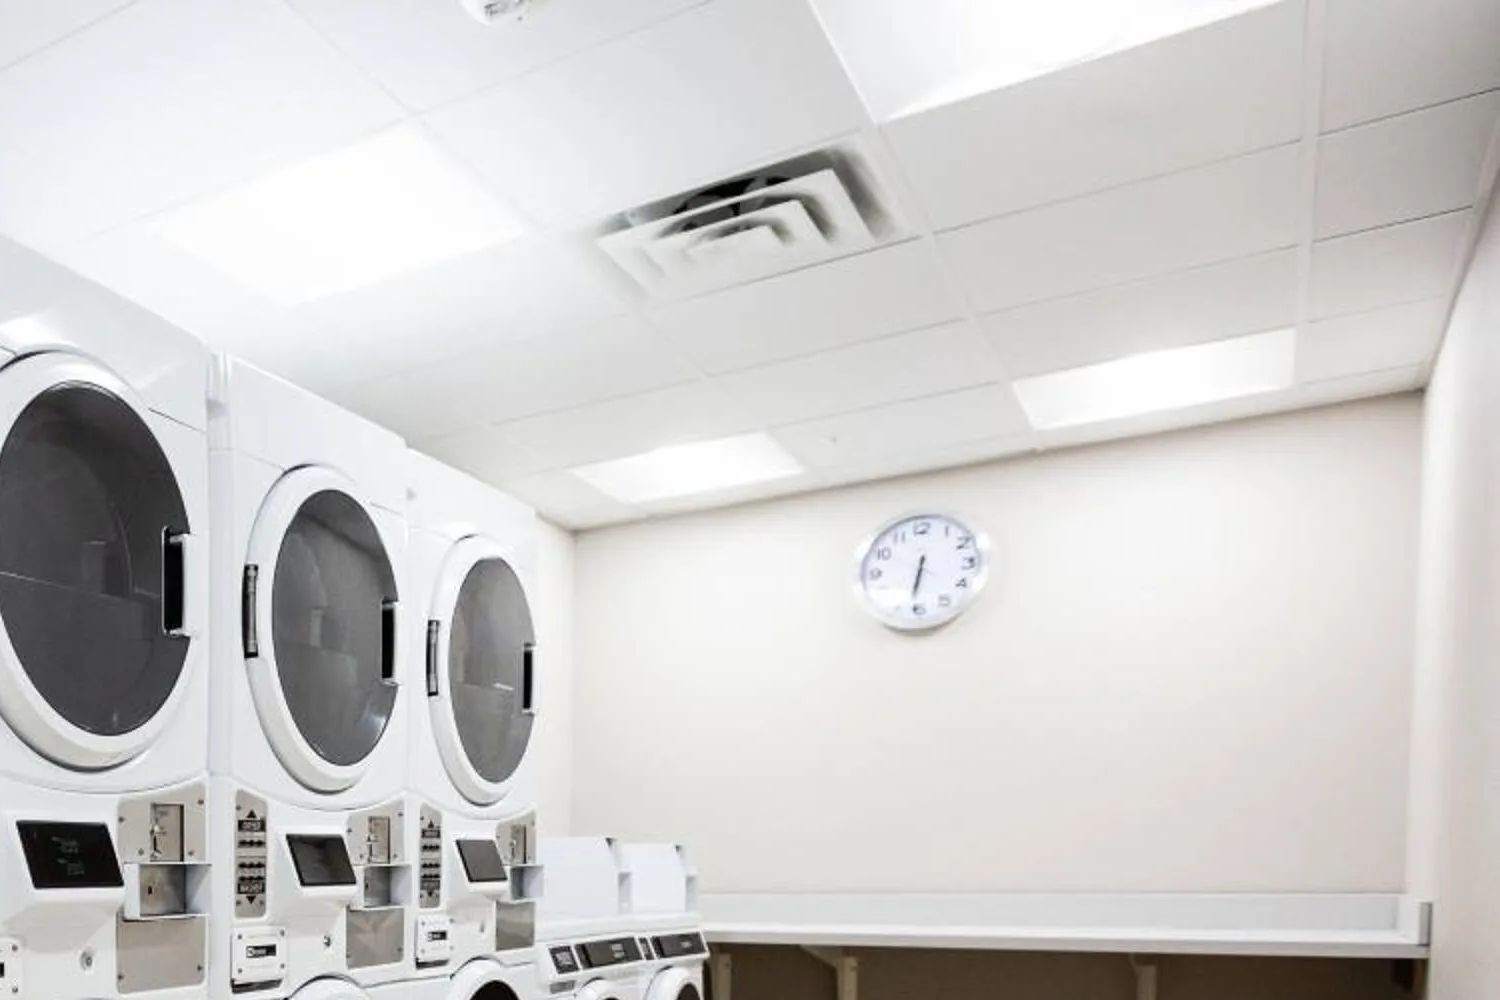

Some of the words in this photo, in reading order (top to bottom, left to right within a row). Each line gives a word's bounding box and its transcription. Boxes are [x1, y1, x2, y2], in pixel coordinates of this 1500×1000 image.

[912, 522, 931, 536] 12
[893, 532, 906, 544] 11
[956, 535, 972, 549] 2
[877, 547, 892, 560] 10
[961, 556, 976, 570] 3
[955, 577, 967, 588] 4
